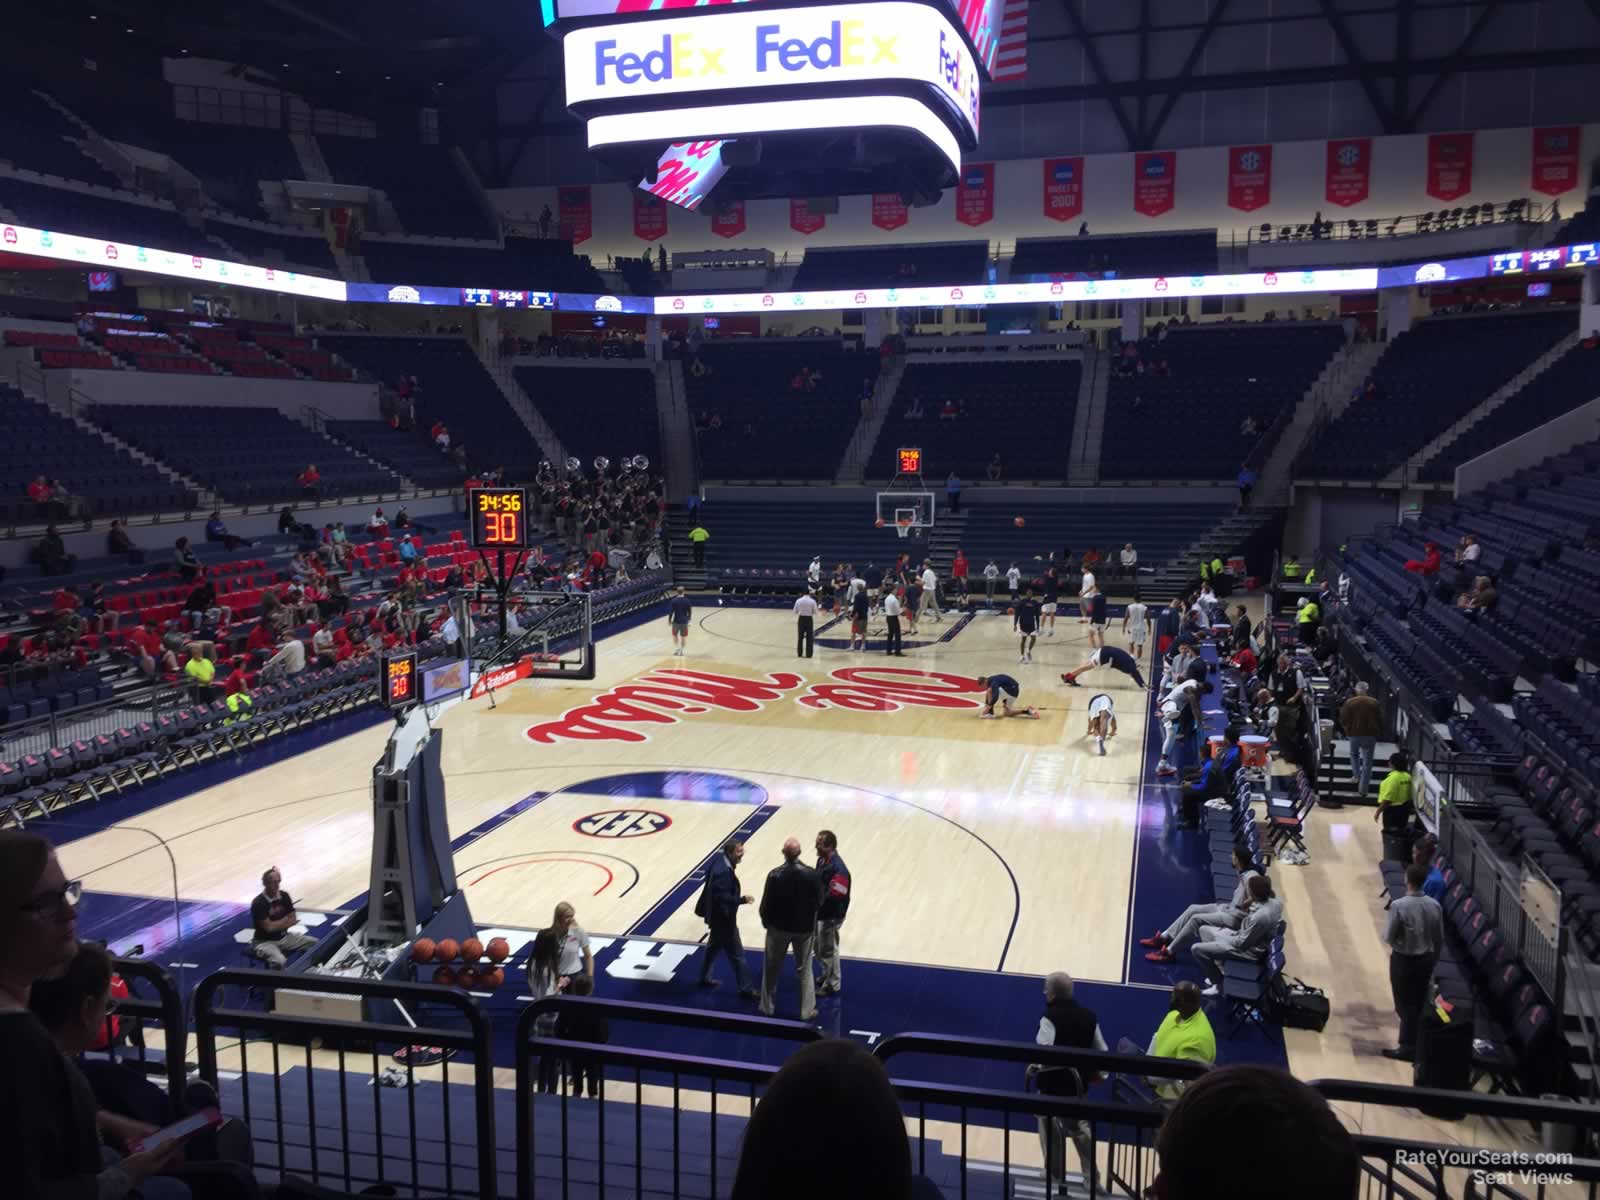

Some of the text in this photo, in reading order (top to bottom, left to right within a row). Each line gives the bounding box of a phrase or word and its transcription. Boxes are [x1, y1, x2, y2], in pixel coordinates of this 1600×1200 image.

[595, 32, 728, 85] FedEx
[756, 19, 900, 73] FedEx
[1530, 249, 1561, 263] 34:56
[498, 291, 523, 301] 34:56
[902, 458, 917, 471] 30
[479, 494, 521, 512] 34:56
[485, 512, 517, 542] 30
[391, 676, 409, 697] 30
